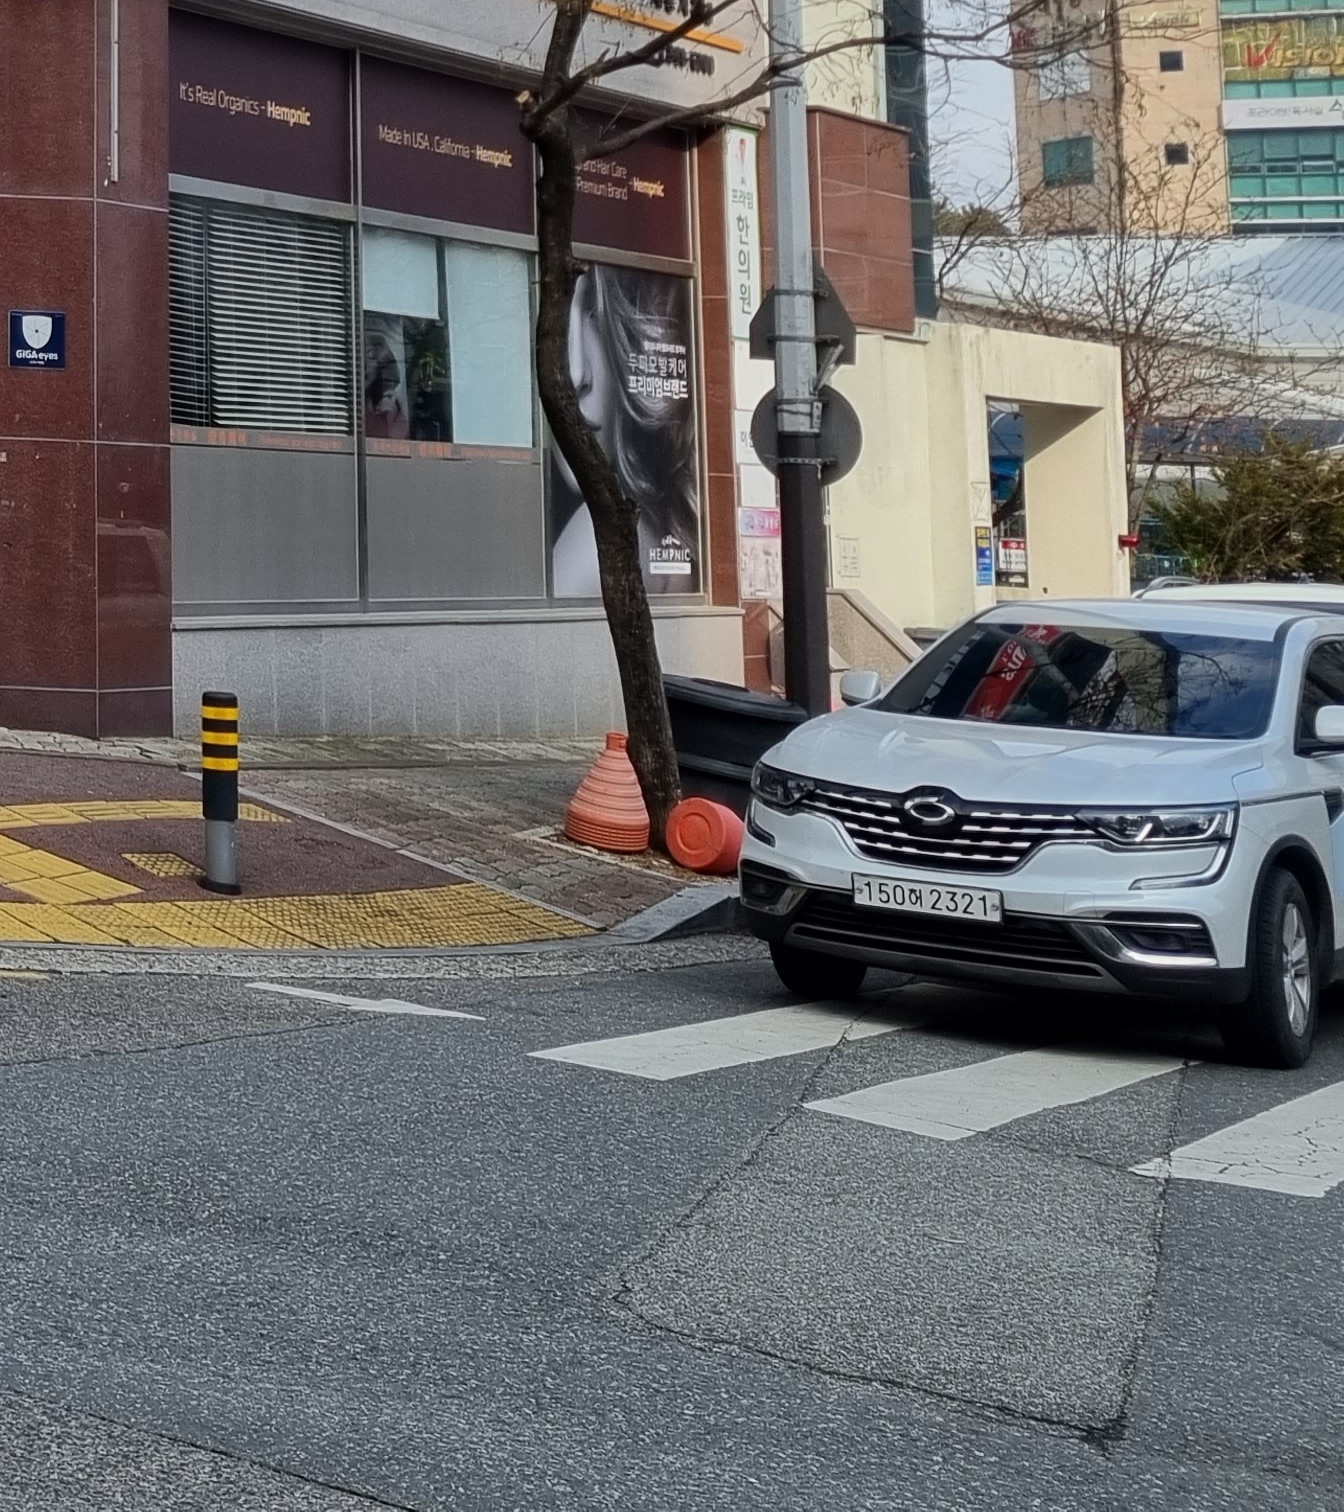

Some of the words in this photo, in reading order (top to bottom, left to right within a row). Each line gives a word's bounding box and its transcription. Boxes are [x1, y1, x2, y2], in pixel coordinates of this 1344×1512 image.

[195, 85, 217, 106] Real
[218, 89, 260, 117] Organics
[266, 100, 311, 127] Hempnic
[378, 123, 402, 146] Made
[476, 144, 512, 168] Hempnic
[730, 187, 754, 210] 프라임
[734, 213, 752, 316] 한의원
[649, 547, 691, 561] HEMPNIC
[929, 889, 989, 917] 2321
